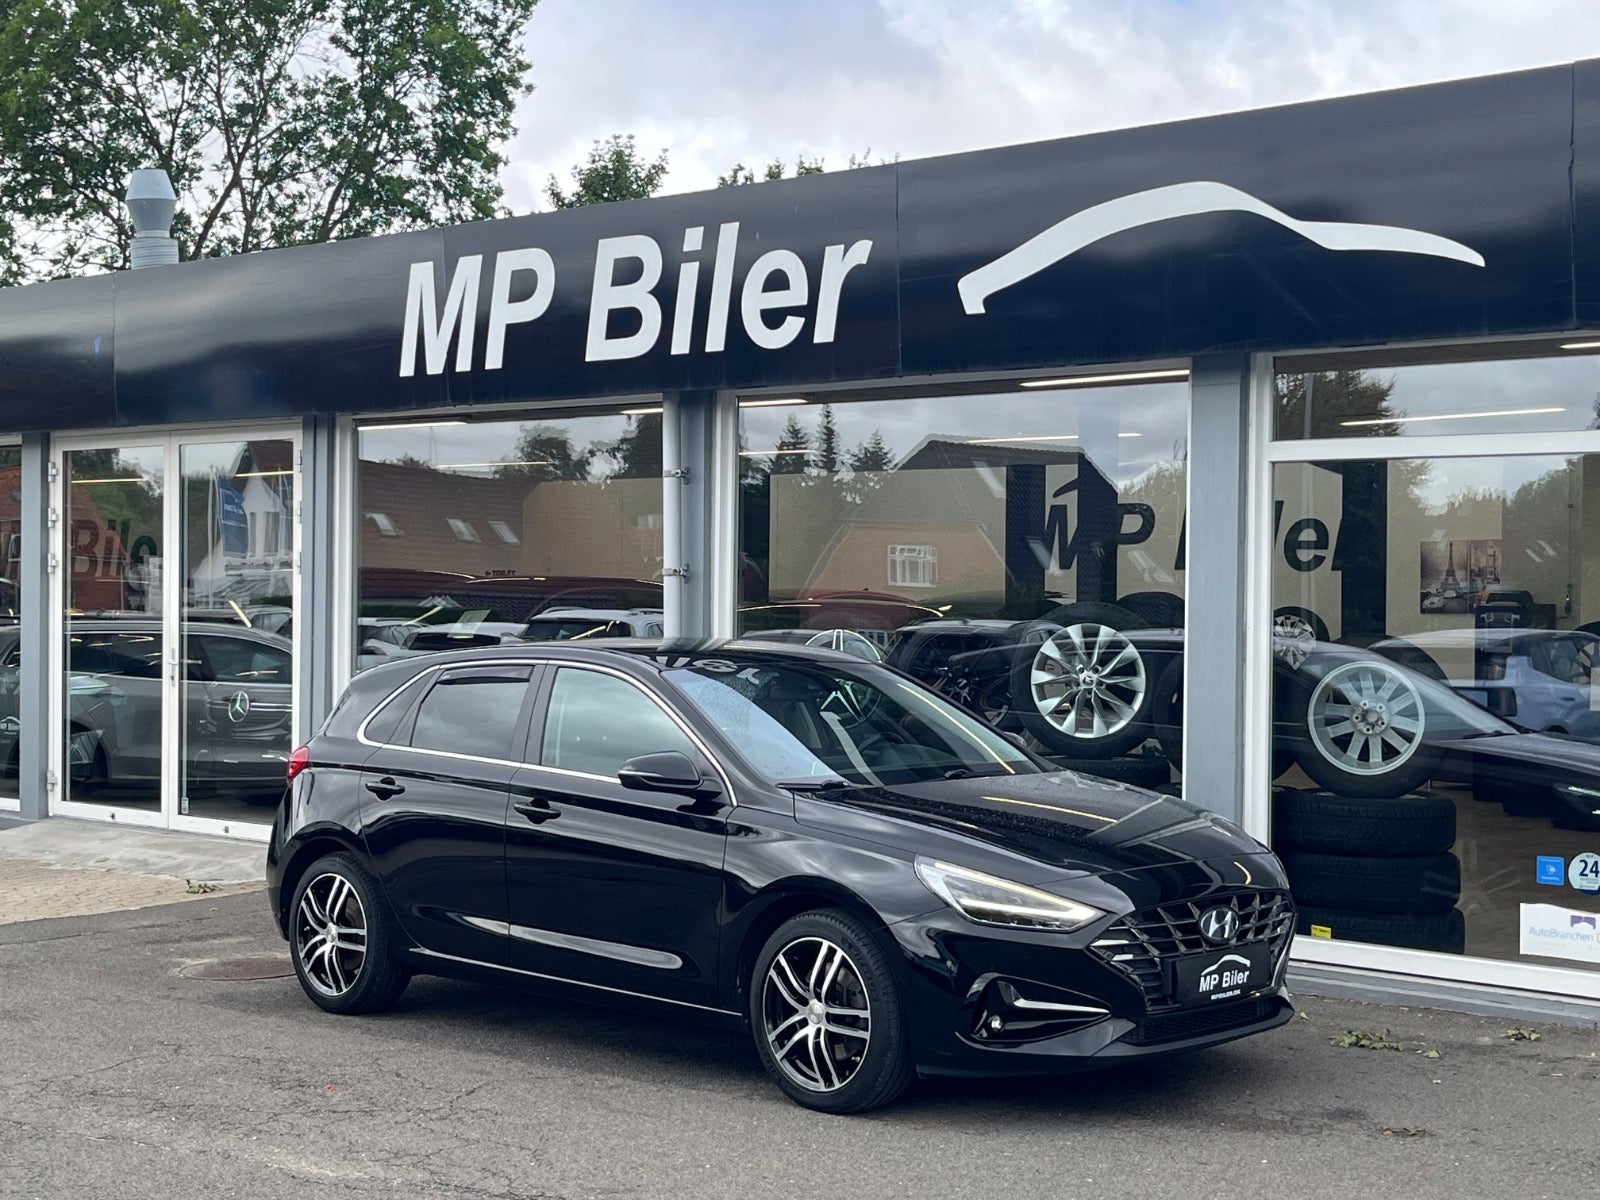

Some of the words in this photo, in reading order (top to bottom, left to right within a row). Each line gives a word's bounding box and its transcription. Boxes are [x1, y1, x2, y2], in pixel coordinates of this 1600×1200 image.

[399, 247, 556, 378] MP
[585, 221, 874, 363] Biler
[1579, 859, 1600, 878] 24
[1529, 926, 1594, 942] AutoBranchen
[1199, 974, 1220, 993] MP
[1222, 969, 1250, 988] Biler
